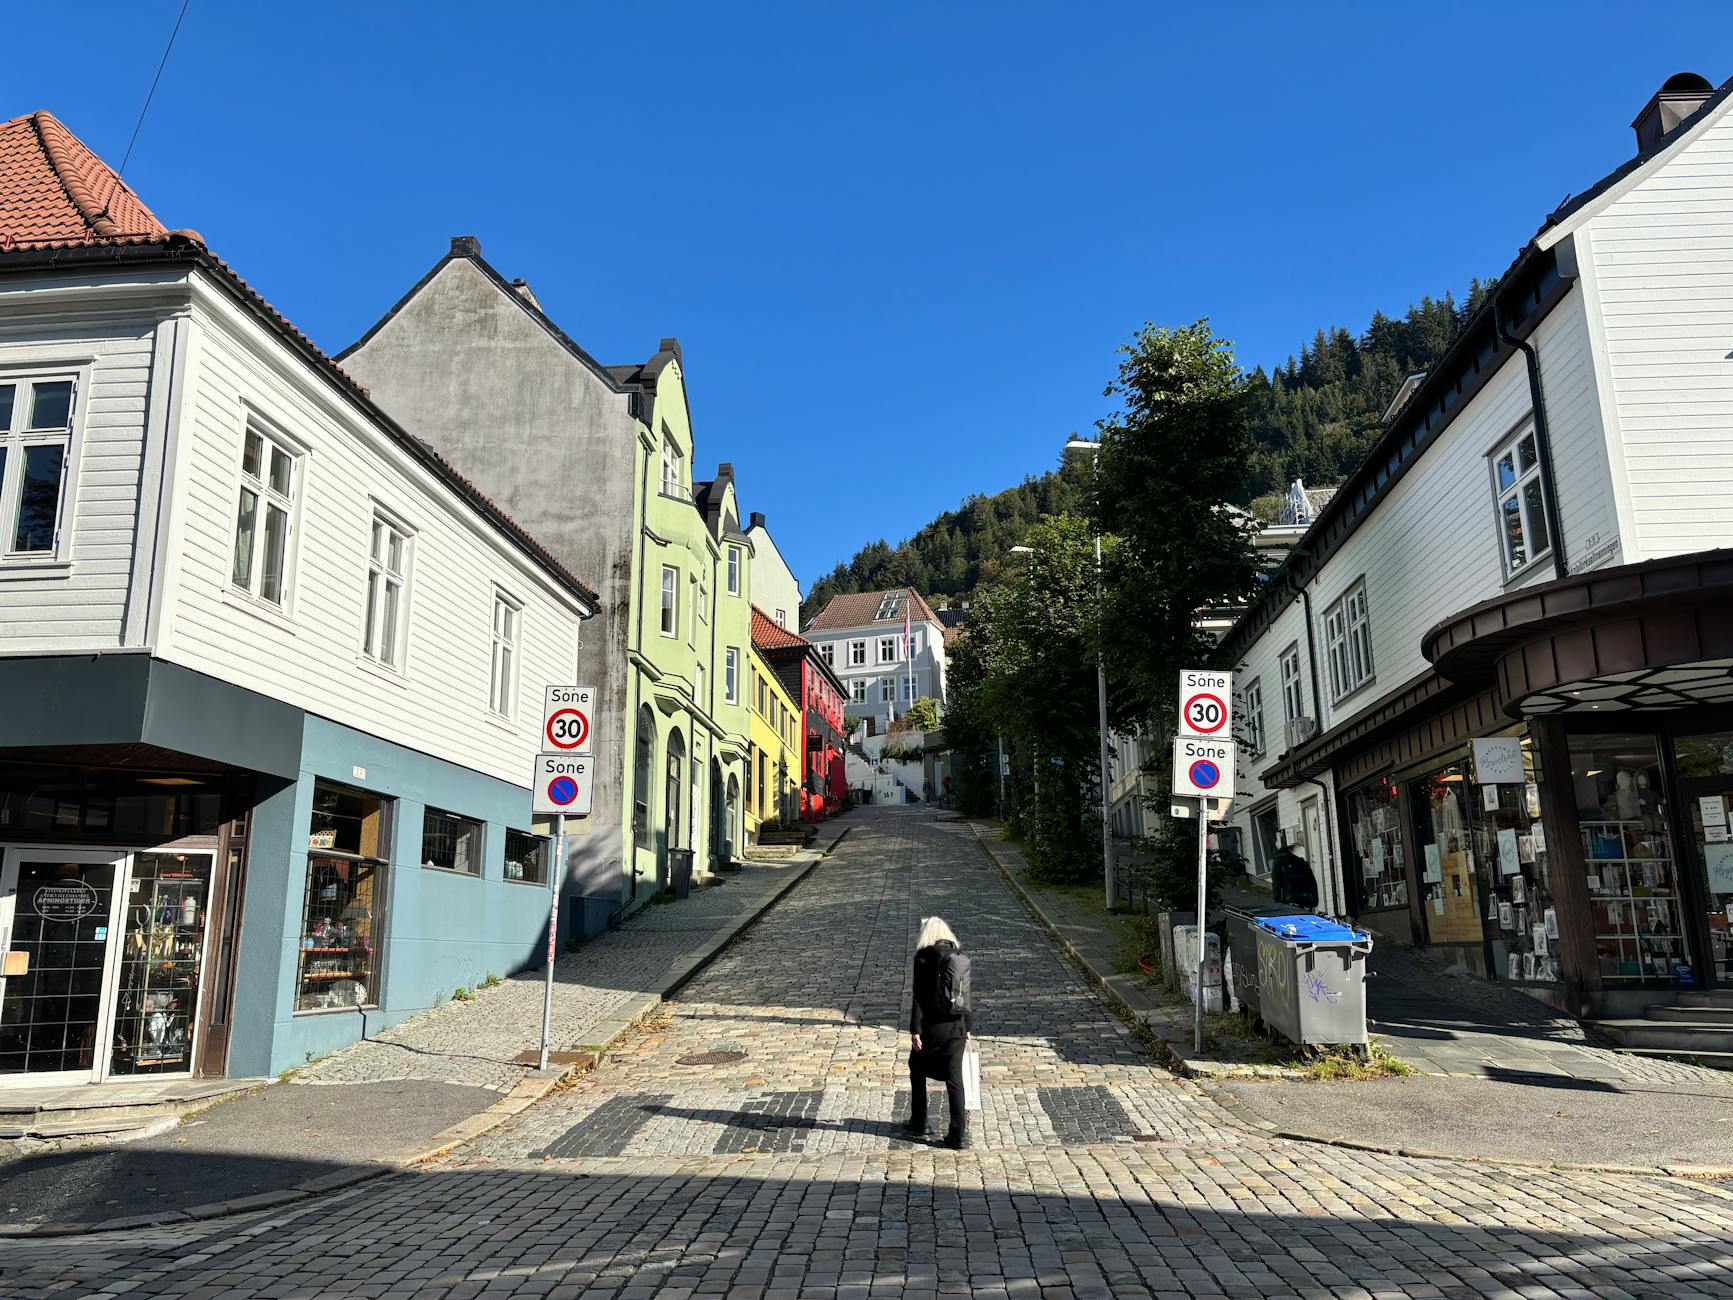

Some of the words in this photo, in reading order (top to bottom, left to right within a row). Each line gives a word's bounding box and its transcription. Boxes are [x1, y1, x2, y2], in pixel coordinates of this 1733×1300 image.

[1187, 674, 1225, 688] Sone
[551, 689, 589, 703] Sone
[1192, 703, 1219, 723] 30
[555, 719, 581, 739] 30
[1185, 743, 1226, 759] Sone
[545, 759, 585, 774] Sone
